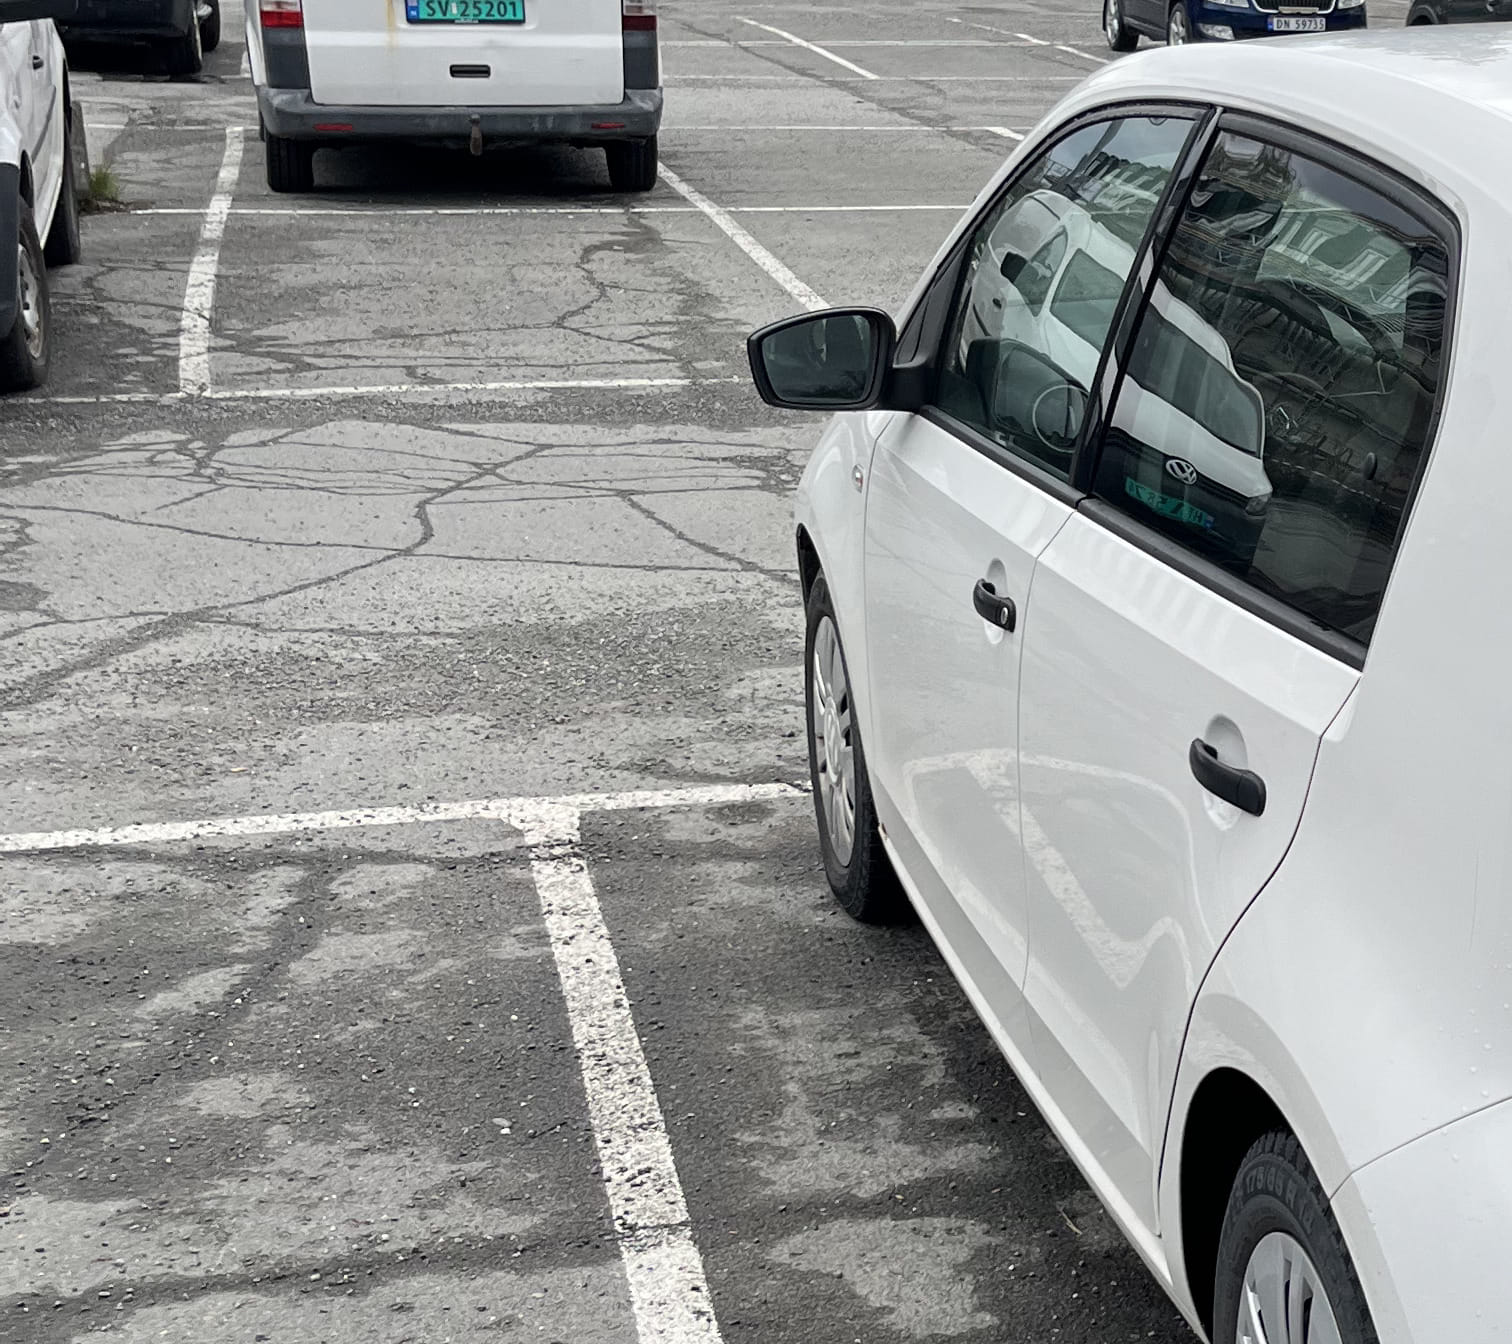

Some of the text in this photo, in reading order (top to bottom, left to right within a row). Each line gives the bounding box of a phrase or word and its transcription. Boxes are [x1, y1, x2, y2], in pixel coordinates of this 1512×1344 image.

[425, 0, 518, 18] SV 25201
[1276, 19, 1325, 30] DN 59735
